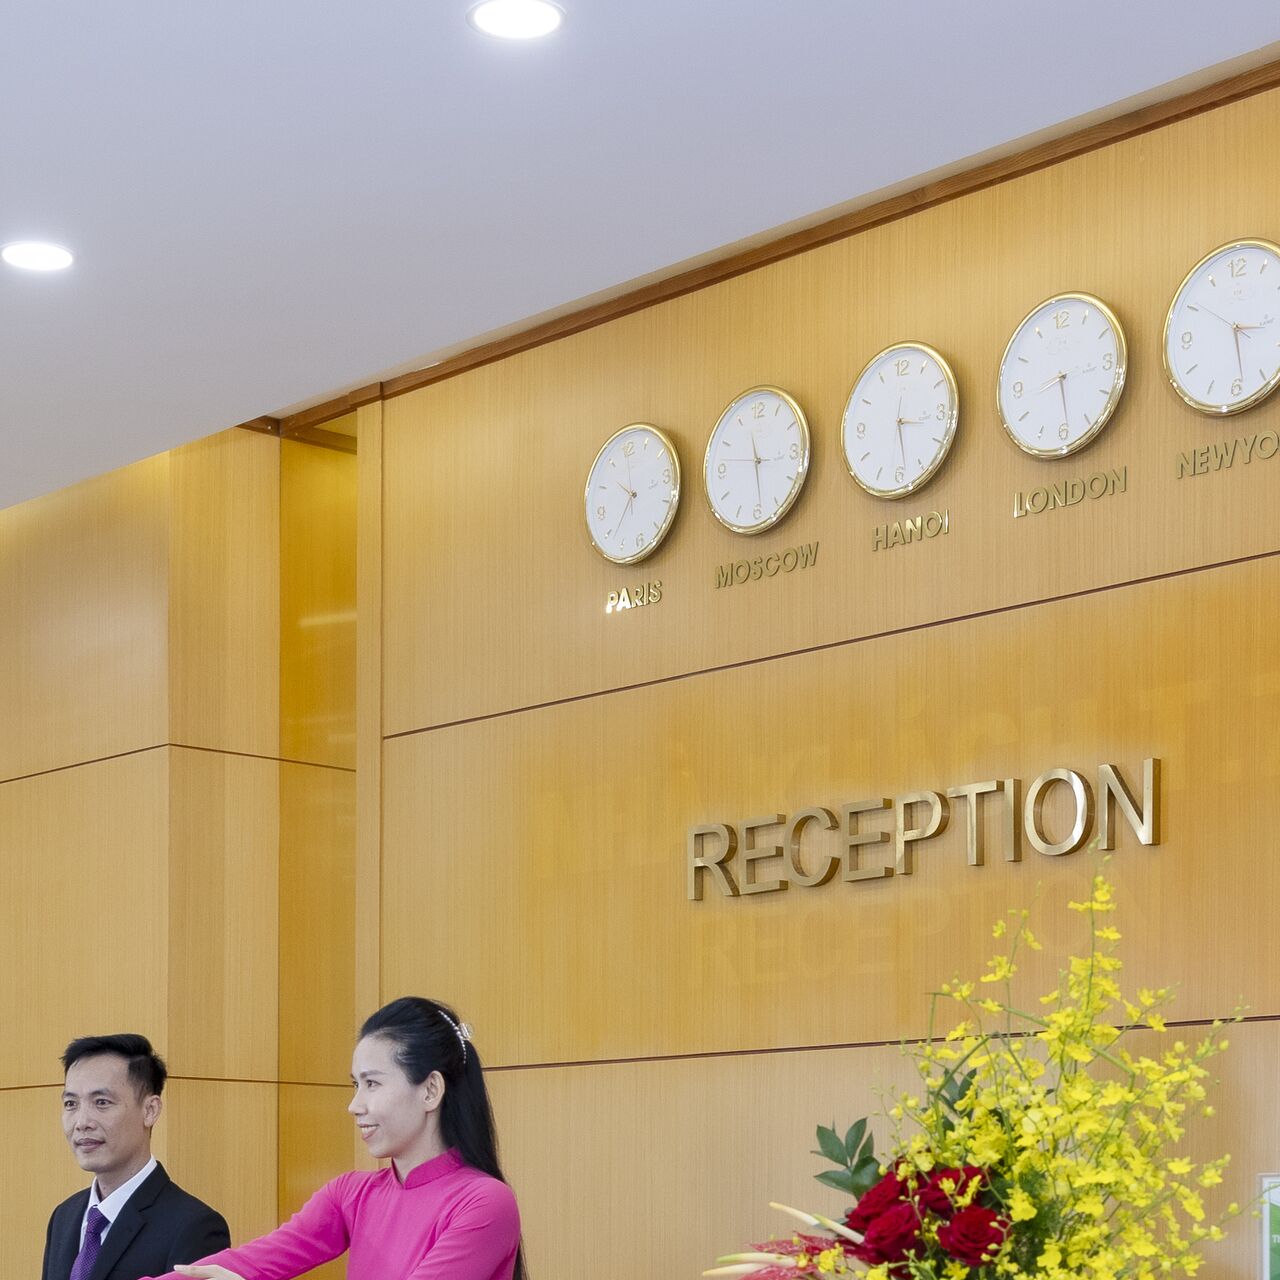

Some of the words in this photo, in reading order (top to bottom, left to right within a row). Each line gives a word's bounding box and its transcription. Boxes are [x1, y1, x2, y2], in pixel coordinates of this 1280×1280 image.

[1227, 258, 1247, 278] 12
[1053, 311, 1070, 329] 12
[1181, 330, 1193, 350] 9
[894, 359, 910, 377] 12
[1102, 352, 1113, 371] 3
[1012, 381, 1023, 399] 9
[1231, 378, 1244, 397] 6
[751, 402, 765, 419] 12
[936, 403, 945, 421] 3
[856, 422, 866, 440] 9
[1058, 423, 1070, 440] 6
[623, 441, 636, 458] 12
[789, 443, 799, 461] 3
[662, 468, 671, 485] 3
[718, 463, 727, 480] 9
[894, 466, 905, 483] 6
[1013, 466, 1128, 519] LONDON
[597, 505, 606, 521] 9
[752, 504, 763, 521] 6
[871, 508, 950, 552] HANOI
[635, 533, 645, 548] 6
[715, 541, 820, 590] MOSCOW
[606, 580, 663, 614] PARIS
[687, 757, 1162, 901] RECEPTION
